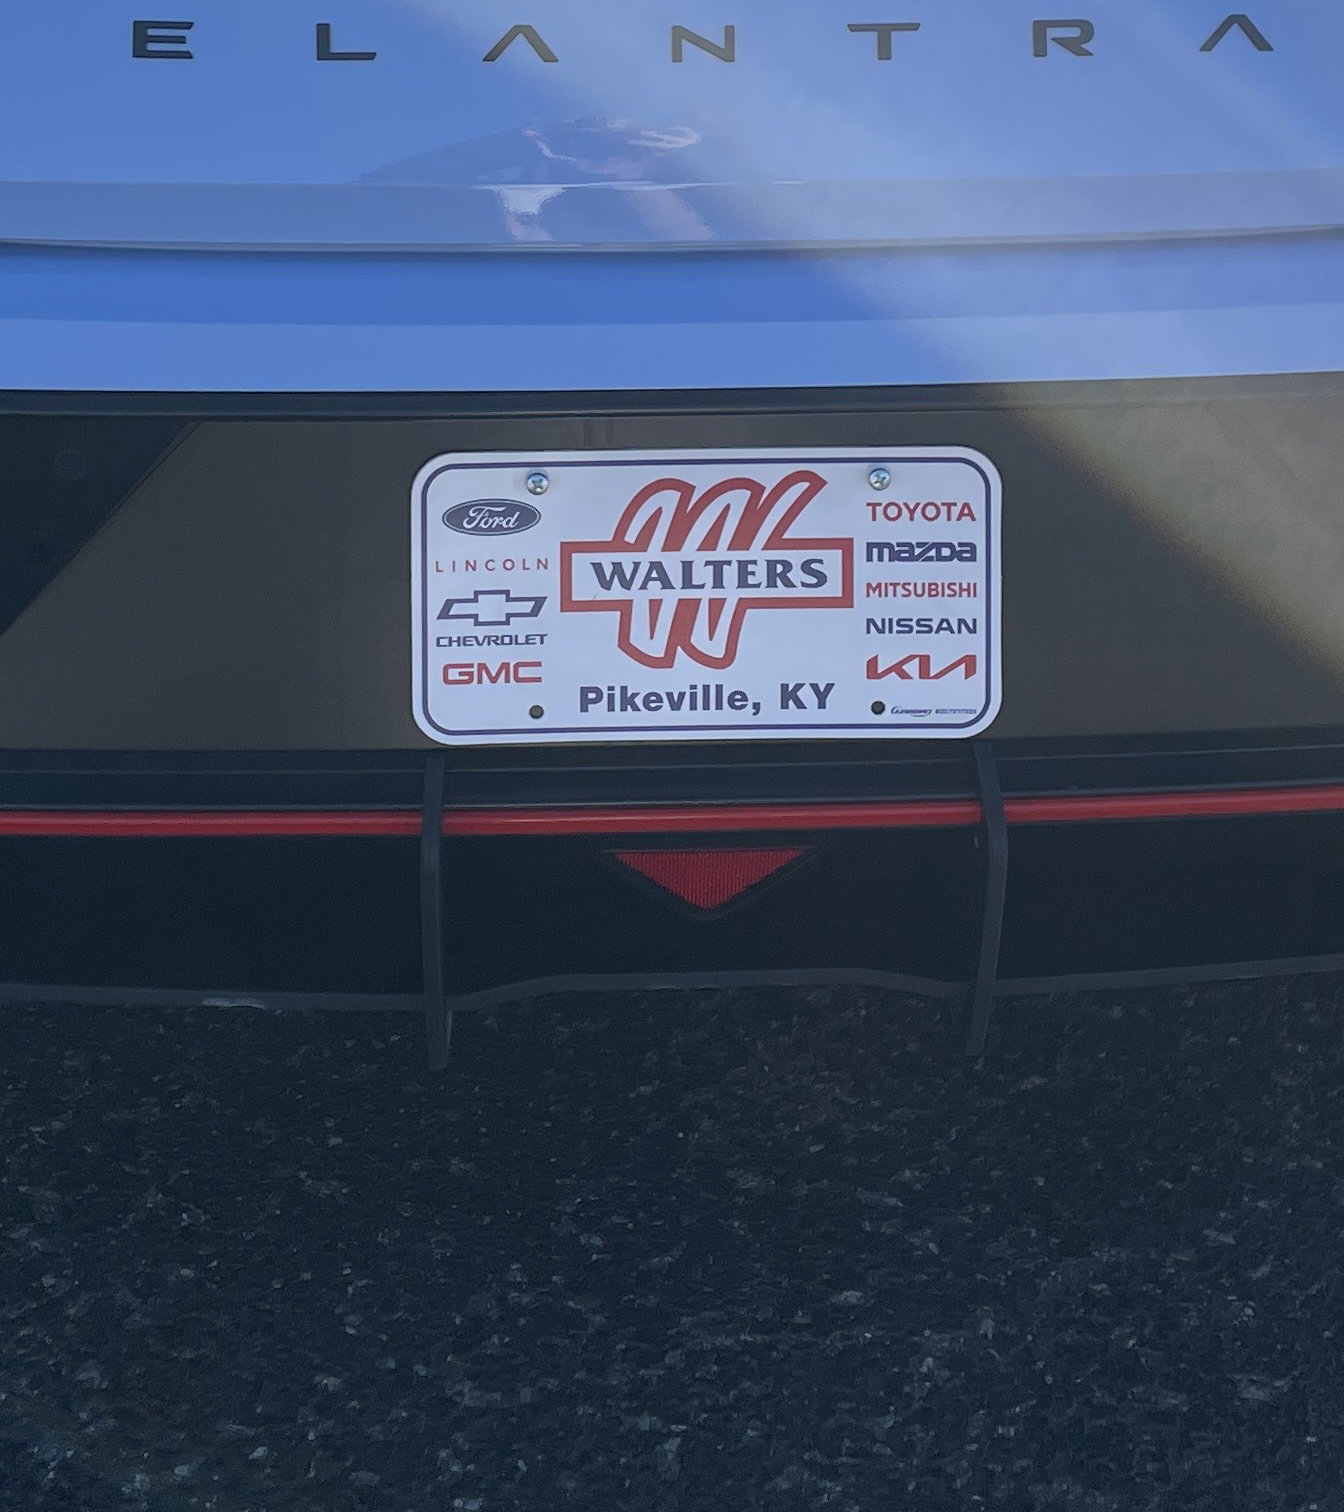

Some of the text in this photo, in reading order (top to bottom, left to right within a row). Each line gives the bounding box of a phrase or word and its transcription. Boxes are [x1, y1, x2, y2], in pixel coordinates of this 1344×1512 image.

[132, 14, 1274, 63] ELANTRA
[462, 505, 521, 530] Ford
[866, 501, 977, 522] TOYOTA
[435, 557, 549, 573] LINCOLN
[590, 558, 829, 592] WALTERS
[865, 582, 978, 598] MITSUBISHI
[865, 617, 978, 635] NISSAN
[436, 633, 548, 648] CHEVROLET
[442, 660, 543, 686] GMC
[579, 682, 835, 716] Pikeville, KY
